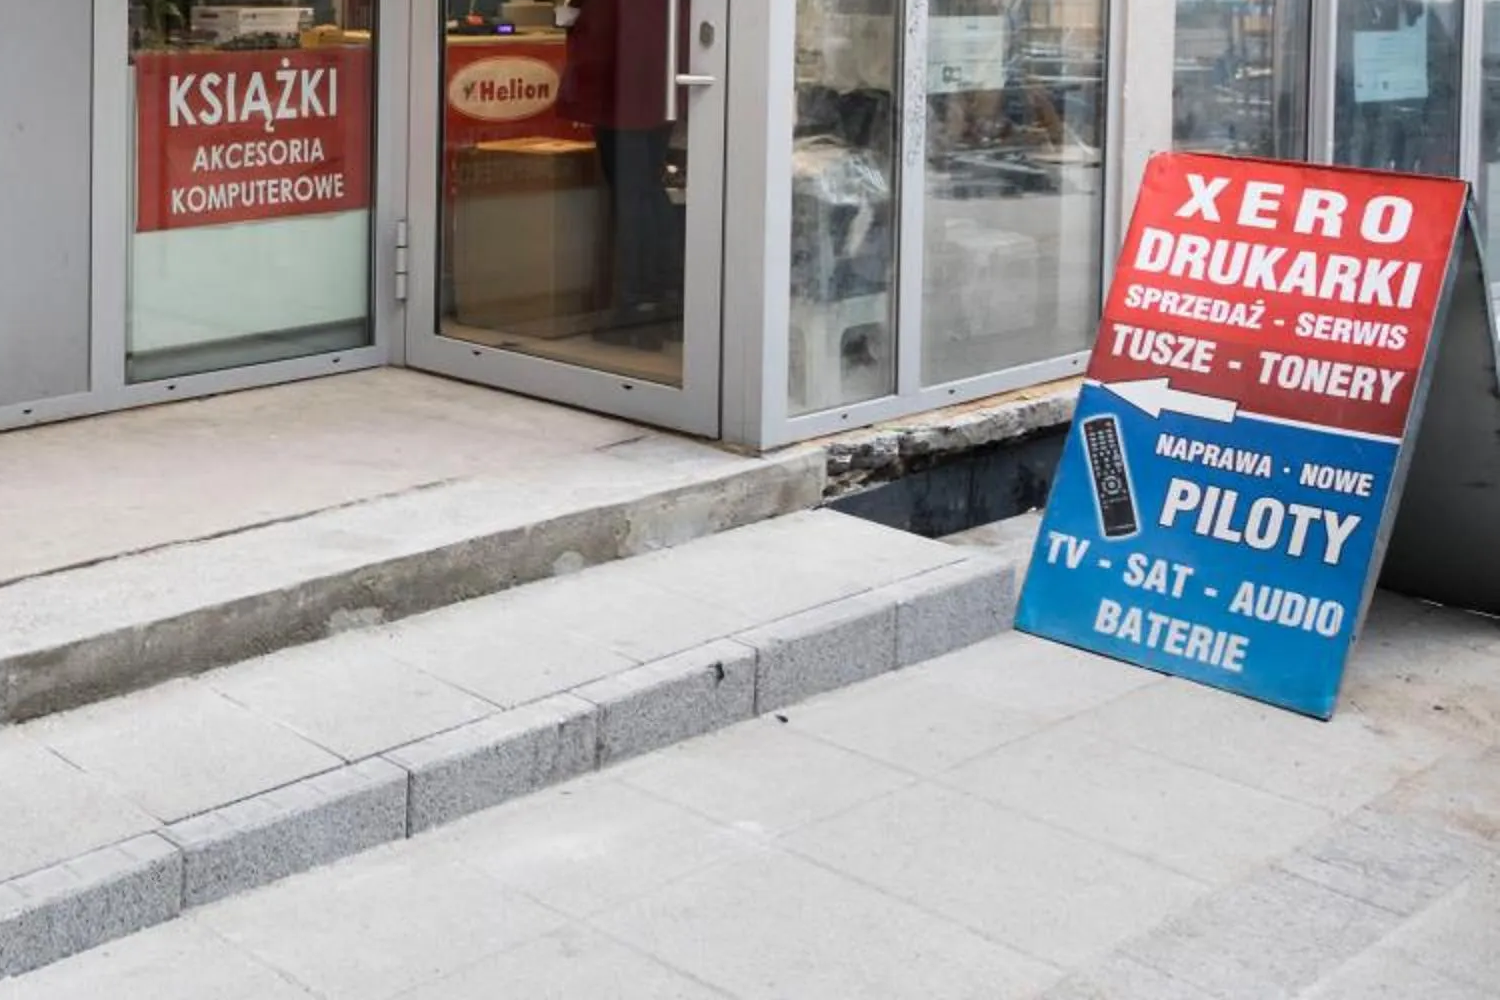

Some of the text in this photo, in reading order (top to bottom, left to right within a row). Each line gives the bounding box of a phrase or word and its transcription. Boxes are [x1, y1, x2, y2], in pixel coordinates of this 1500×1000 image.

[168, 57, 337, 133] KSIĄŻKI
[479, 78, 550, 103] Helion
[192, 137, 325, 172] AKCESORIA
[171, 173, 344, 215] KOMPUTEROWE
[1173, 172, 1414, 244] XERO
[1134, 226, 1422, 309] DRUKARKI
[1124, 284, 1266, 329] SPRZEDAŻ
[1295, 312, 1408, 350] SERWIS
[1111, 323, 1217, 373] TUSZE
[1258, 351, 1405, 405] TONERY
[1155, 432, 1272, 479] NAPRAWA
[1299, 462, 1374, 498] NOWE
[1158, 477, 1361, 566] PILOTY
[1047, 530, 1090, 569] TV
[1123, 552, 1194, 599] SAT
[1228, 581, 1345, 638] AUDIO
[1093, 598, 1249, 673] BATERIE
